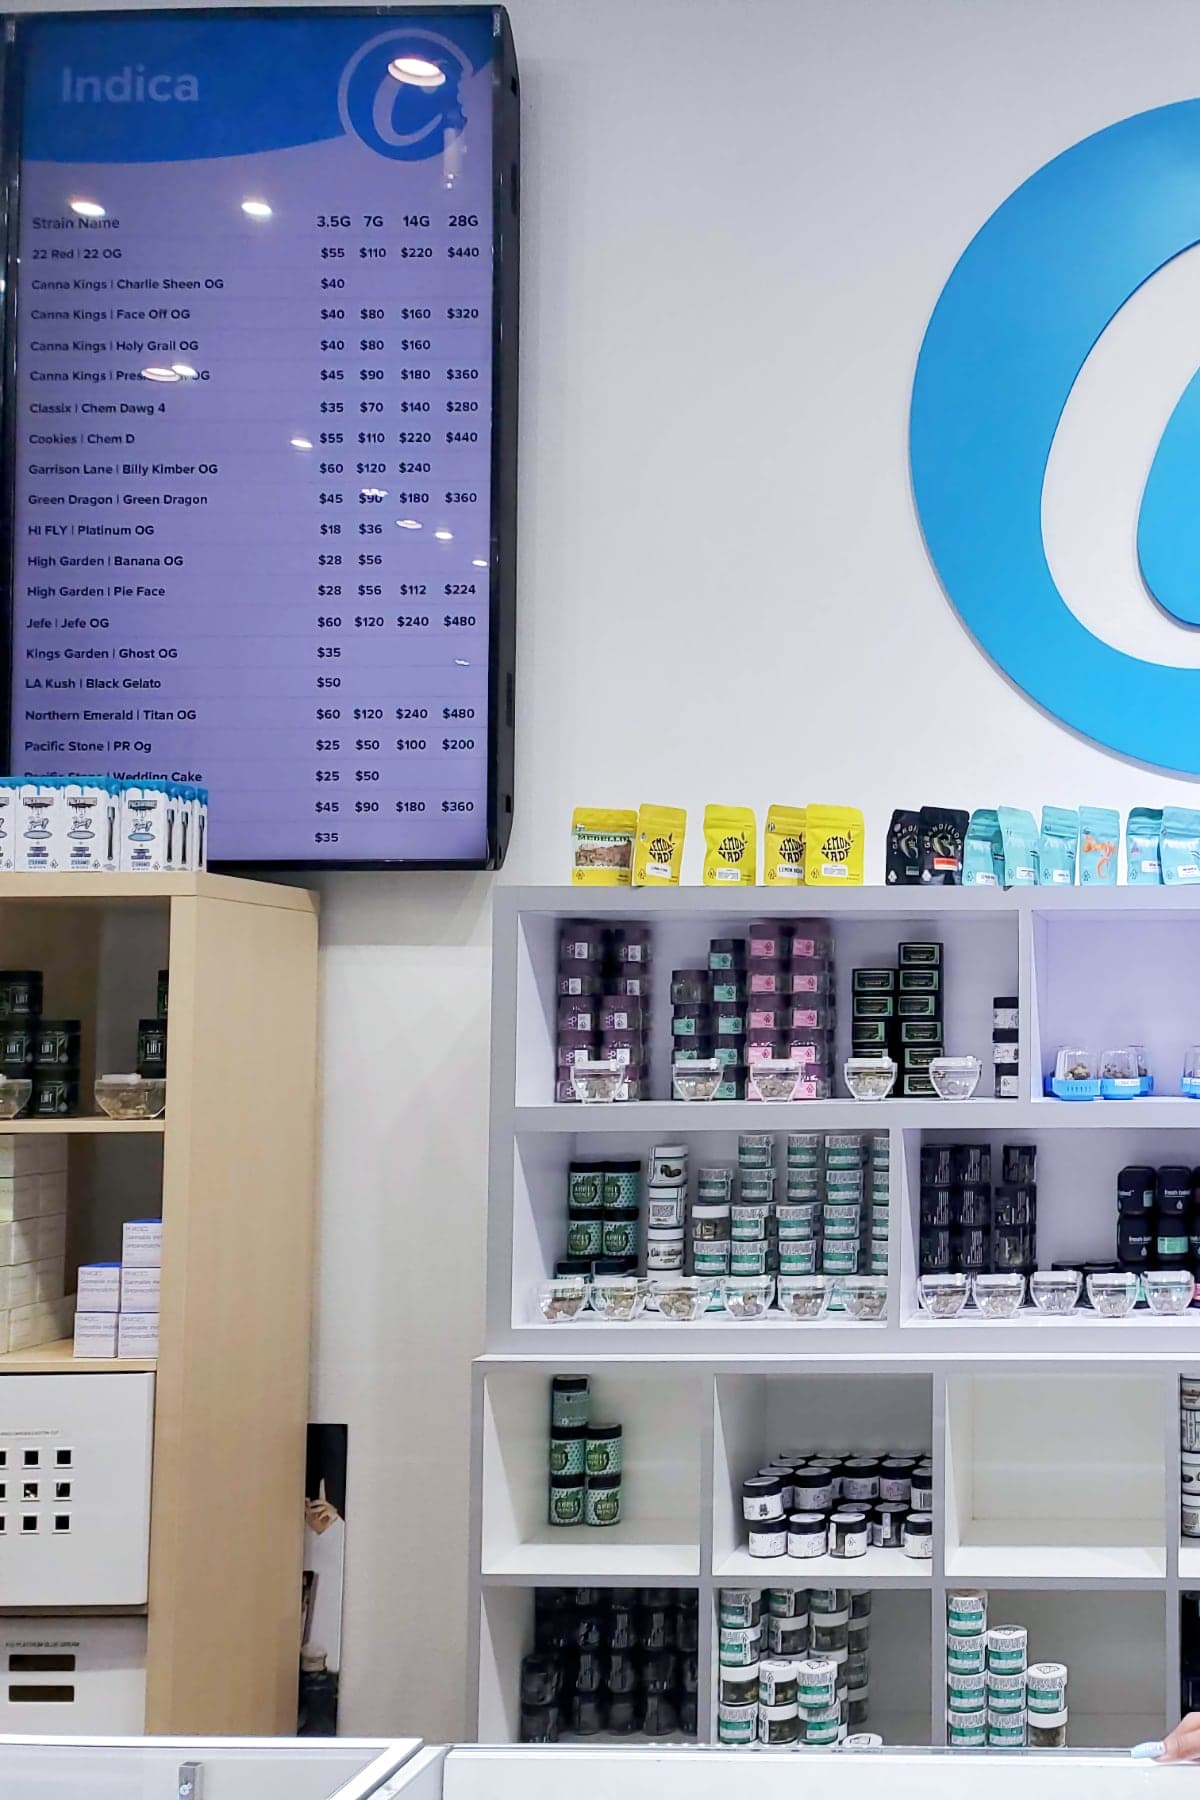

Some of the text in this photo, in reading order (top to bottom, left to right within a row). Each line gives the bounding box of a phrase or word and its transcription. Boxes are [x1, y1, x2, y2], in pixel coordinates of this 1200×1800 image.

[61, 67, 199, 102] Indica
[31, 216, 121, 230] Strain Name
[316, 214, 479, 228] 3.5G 7G 14G 28G
[32, 248, 123, 260] 22 Red 22 OG
[321, 246, 480, 260] $55 $110 $220 $440
[31, 278, 224, 292] Canna Kings Charlie Sheen OG
[320, 277, 345, 290] $40
[30, 308, 191, 322] Canna Kings Face Off OG
[30, 340, 199, 354] Canna Kings Holy Grail OG
[29, 370, 107, 384] Canna Kings
[29, 402, 166, 416] Classix Chem Dawg 4
[320, 401, 479, 414] $35 $70 $140 $280
[28, 433, 136, 445] Cookies Chem D
[28, 463, 218, 477] Garrison Lane Billy Kimber OG
[319, 462, 431, 475] $60 $120 $240
[28, 494, 208, 507] Green Dragon Green Dragon
[28, 524, 155, 536] HI FLY Platinum OG
[319, 523, 383, 536] $18 $36
[27, 555, 184, 569] High Garden Banana OG
[318, 553, 383, 566] $28 $56
[27, 585, 166, 600] High Garden Pie Face
[26, 617, 110, 629] Jefe Jefe OG
[26, 648, 178, 662] Kings Garden Ghost OG
[317, 646, 341, 659] $35
[25, 677, 162, 689] LA Kush Black Gelato
[316, 676, 341, 689] $50
[25, 709, 197, 721] Northern Emerald Titan OG
[316, 707, 475, 721] $60 $120 $240 $480
[24, 740, 152, 754] Pacific Stone PR Og
[171, 771, 203, 782] Cake
[315, 770, 380, 783] $25 $50
